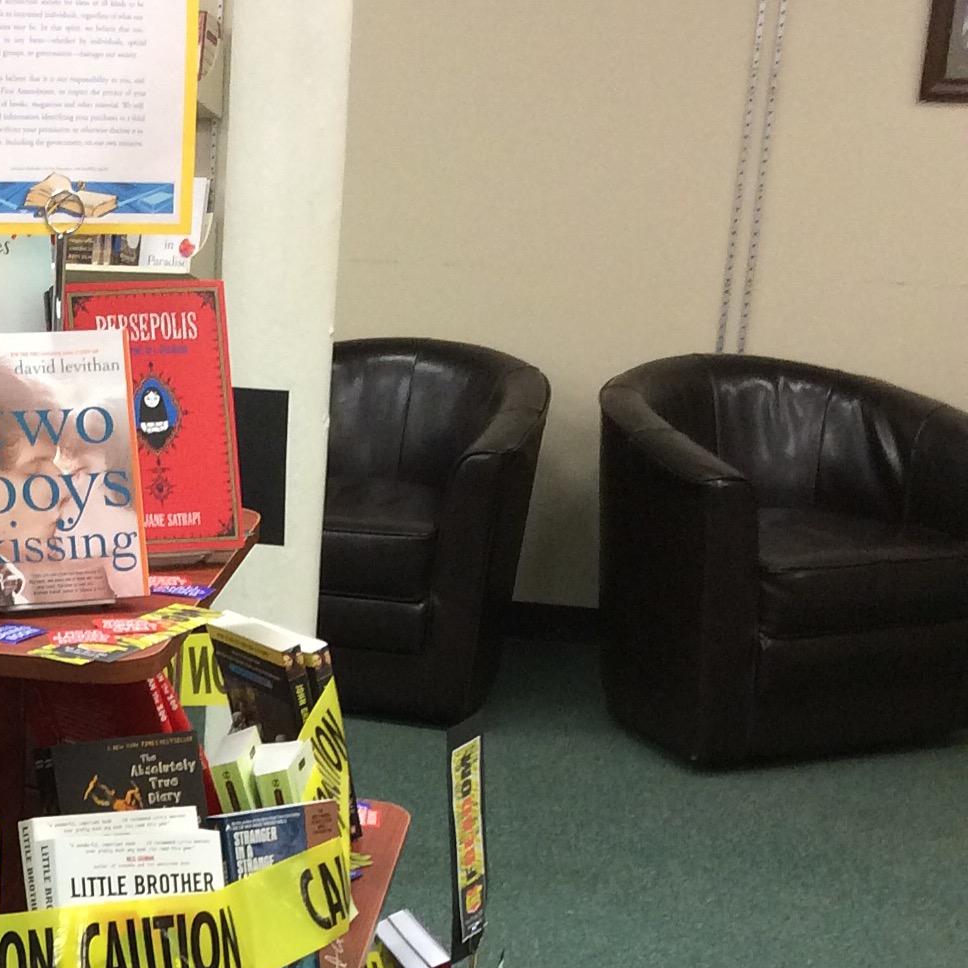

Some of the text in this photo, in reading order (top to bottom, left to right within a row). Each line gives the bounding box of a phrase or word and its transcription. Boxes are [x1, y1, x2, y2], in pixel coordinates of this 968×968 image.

[95, 311, 198, 342] PERSEPOLIS
[14, 357, 120, 375] david levithan
[167, 511, 201, 527] SATRAPI
[130, 758, 196, 778] Absolutely
[139, 753, 157, 764] The
[149, 777, 179, 788] True
[147, 790, 182, 805] Diary
[22, 826, 33, 866] LITTLE
[233, 826, 278, 847] STRANGER
[234, 844, 254, 860] IN A
[40, 845, 52, 884] LITTLE
[70, 871, 215, 898] LITTLE BROTHER
